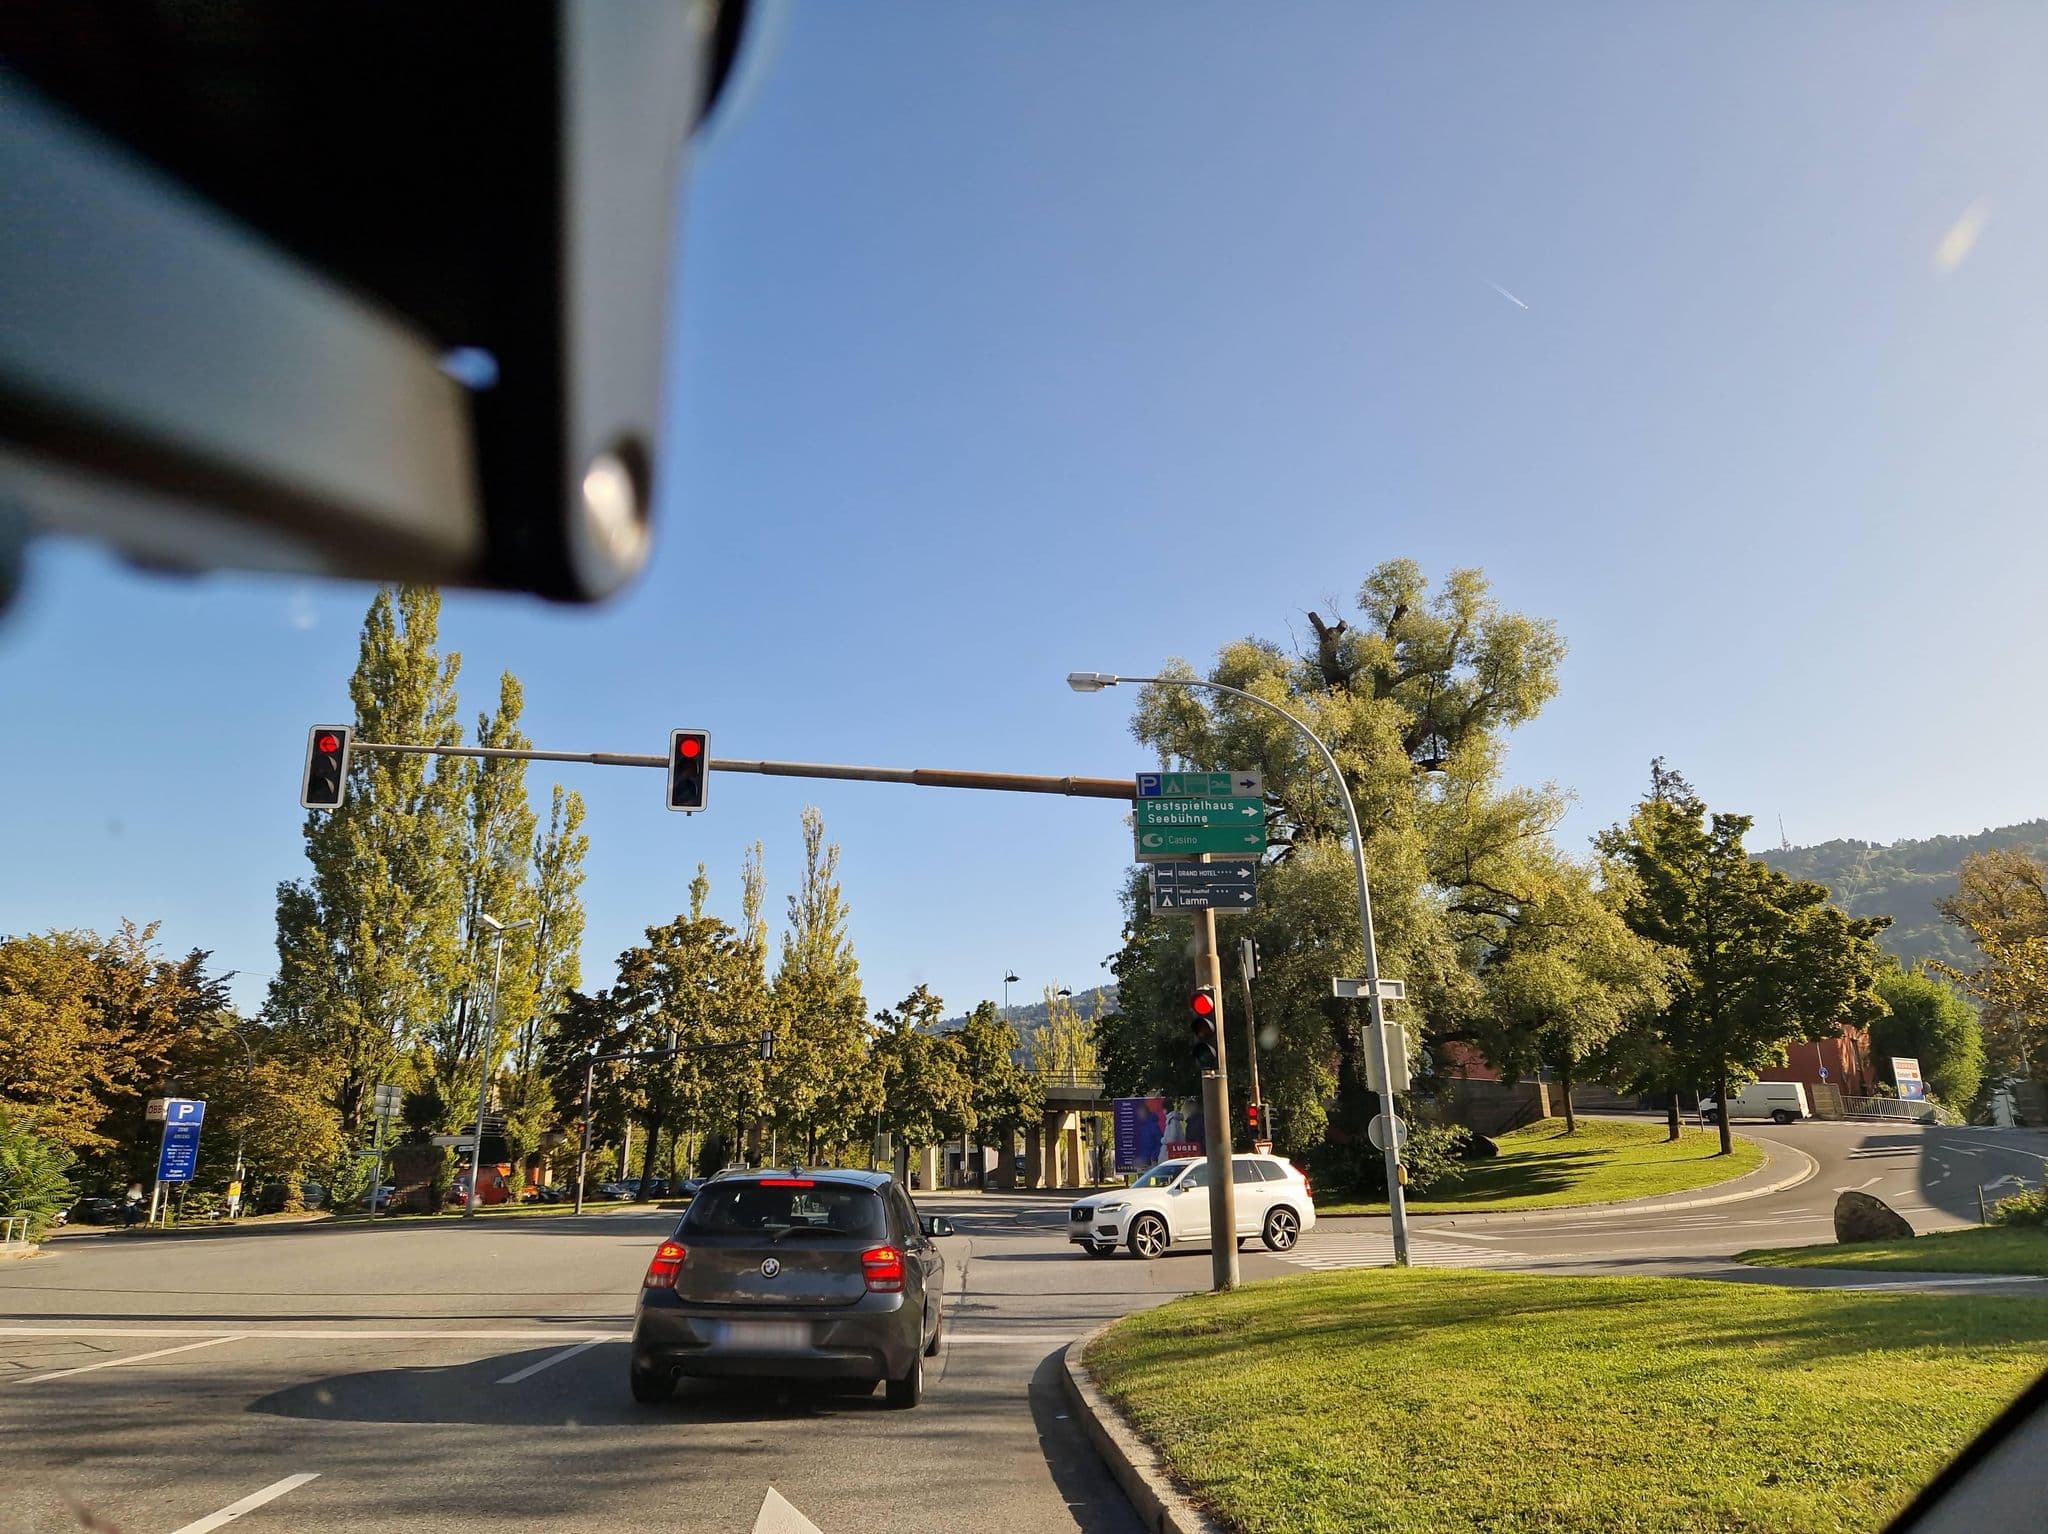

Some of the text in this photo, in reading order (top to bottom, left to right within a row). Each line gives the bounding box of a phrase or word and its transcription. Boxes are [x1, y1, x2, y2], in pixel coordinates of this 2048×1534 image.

[1140, 776, 1157, 795] P
[1147, 800, 1234, 812] Festspielhaus
[1148, 813, 1208, 823] Seebühne
[1168, 835, 1198, 845] Casino
[1180, 895, 1209, 905] Lamm
[178, 1104, 194, 1119] P
